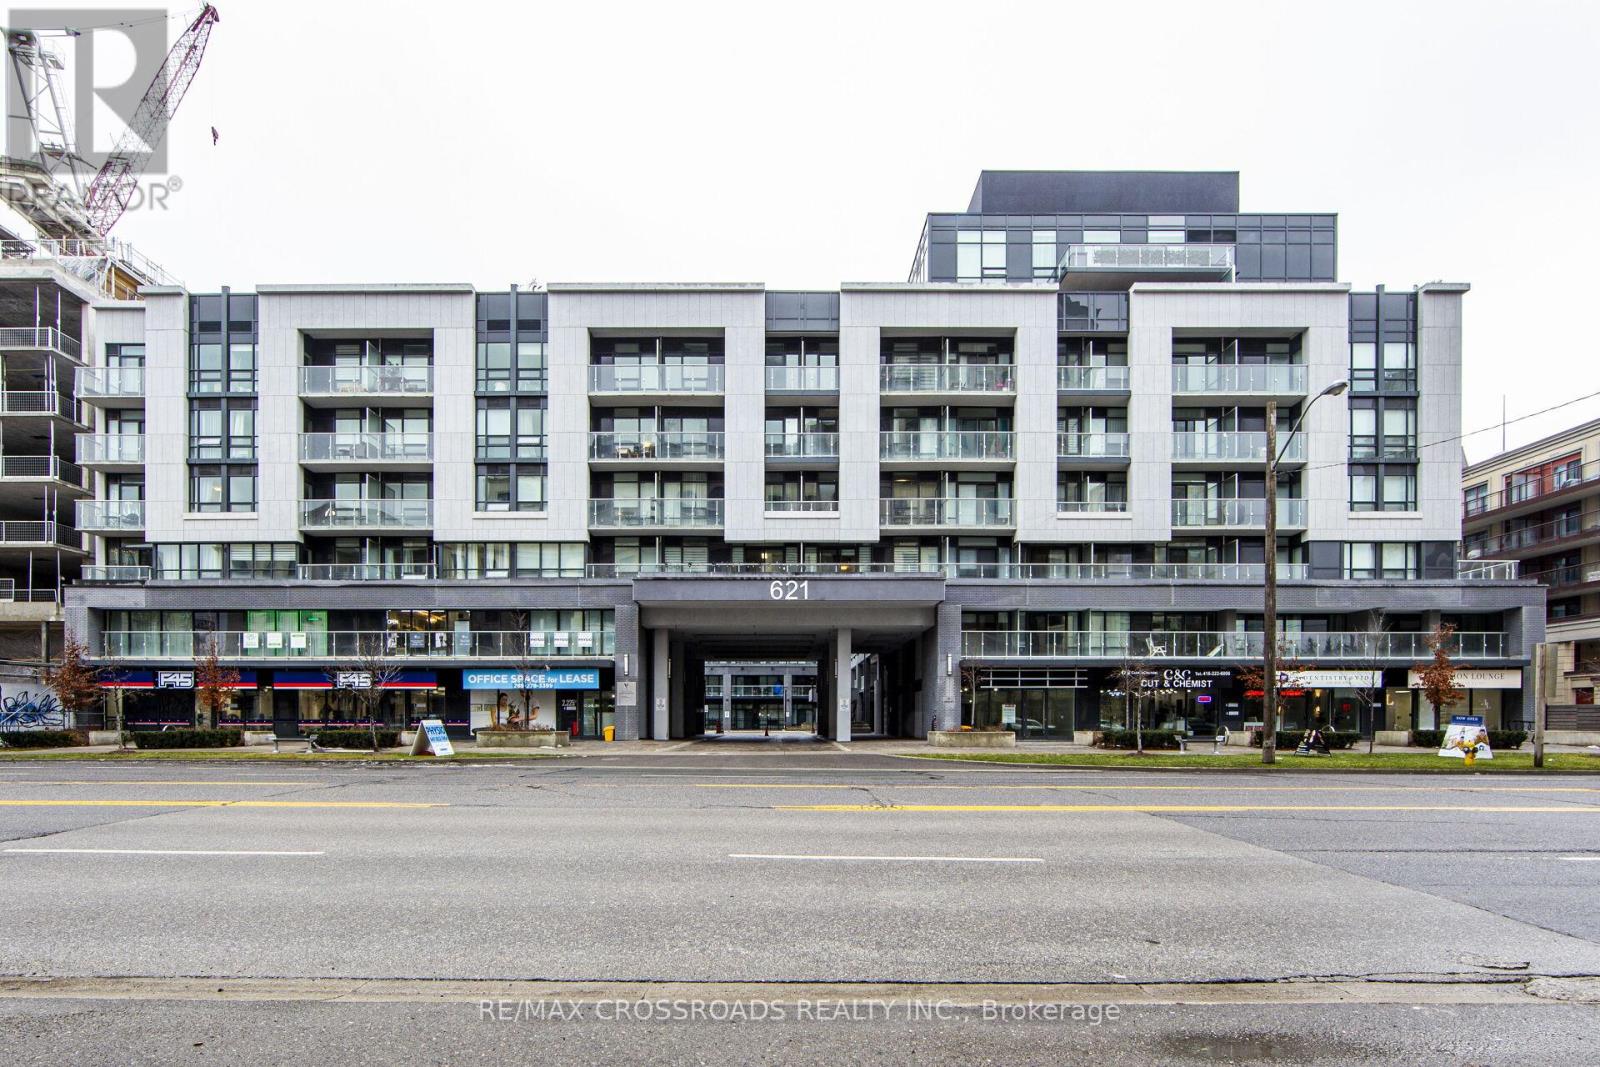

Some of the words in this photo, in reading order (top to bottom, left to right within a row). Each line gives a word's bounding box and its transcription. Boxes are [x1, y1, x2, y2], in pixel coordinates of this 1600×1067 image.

[770, 580, 808, 600] 621
[159, 671, 194, 688] F45
[337, 671, 372, 688] F45
[468, 674, 508, 684] OFFICE
[510, 674, 546, 684] SPACE
[547, 676, 557, 684] for
[559, 674, 595, 684] LEASE
[1163, 669, 1191, 680] C&C
[1471, 672, 1505, 680] LOUNGE
[1140, 679, 1159, 688] CUT
[1163, 679, 1170, 688] &
[1173, 679, 1213, 688] CHEMIST
